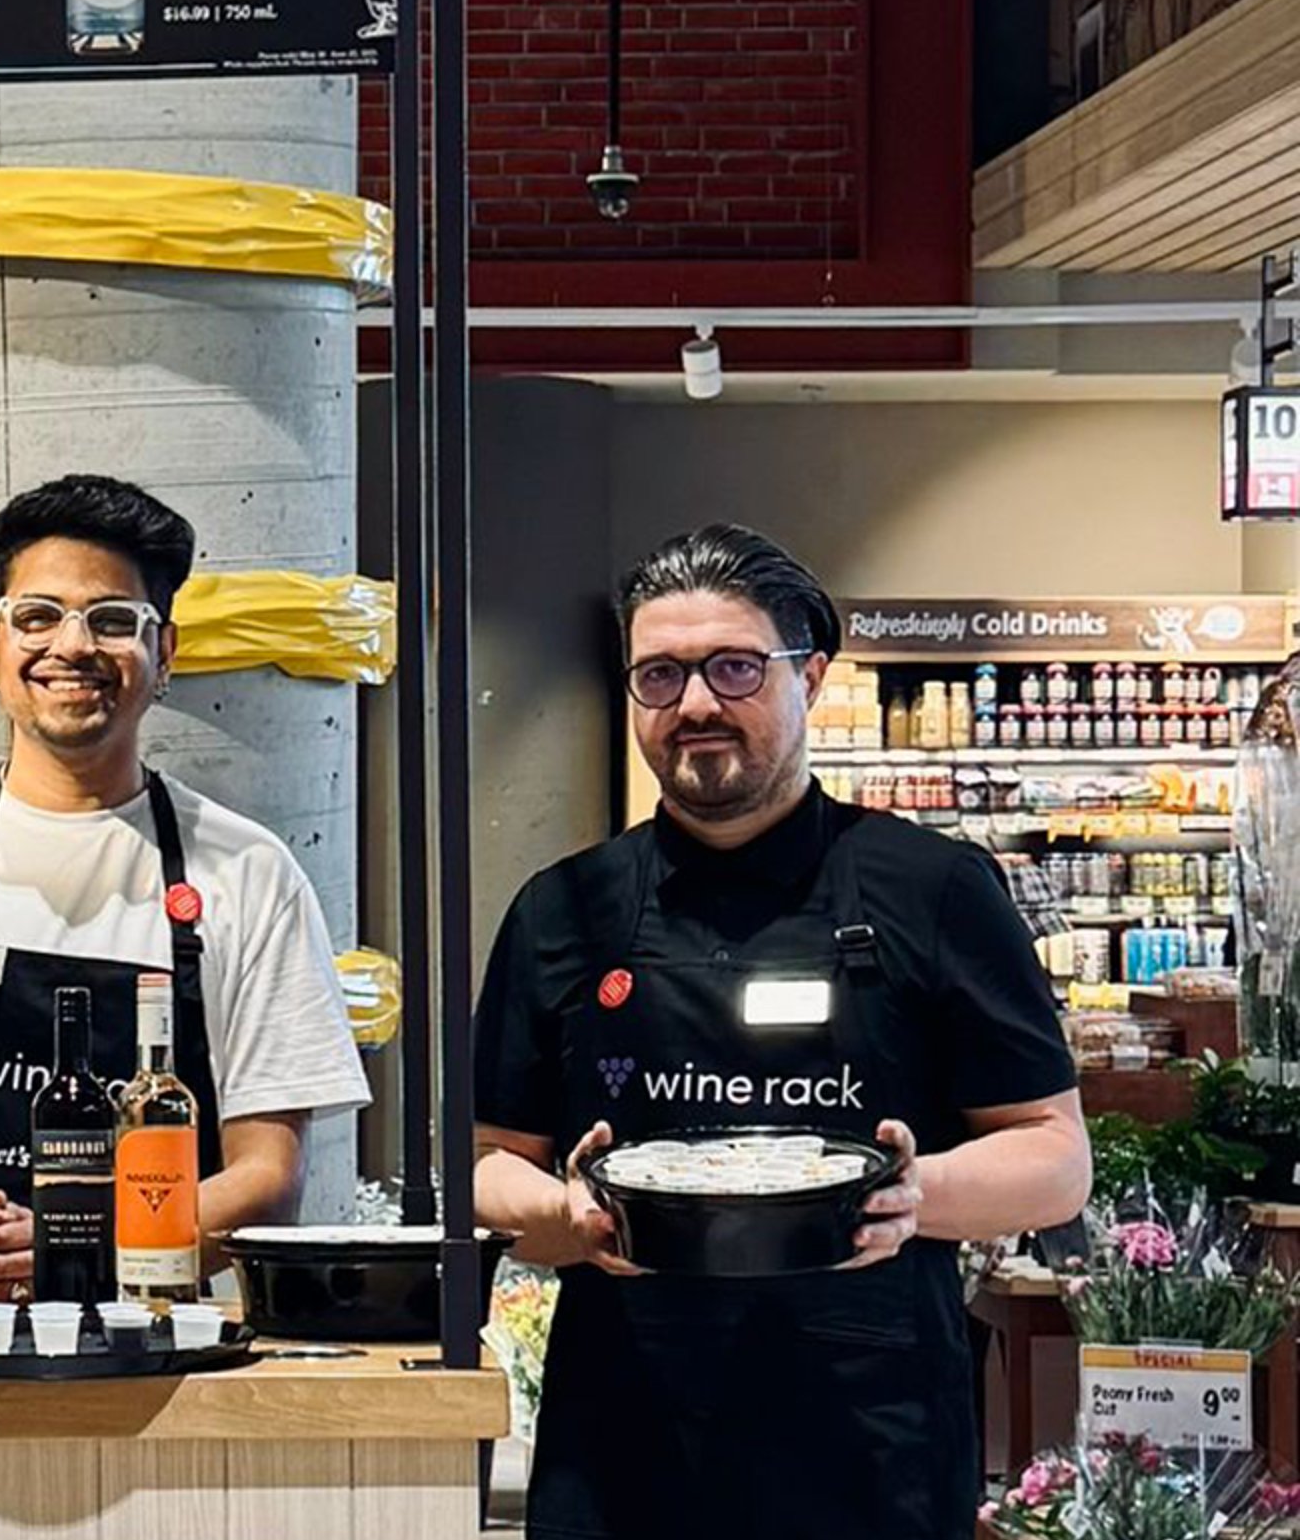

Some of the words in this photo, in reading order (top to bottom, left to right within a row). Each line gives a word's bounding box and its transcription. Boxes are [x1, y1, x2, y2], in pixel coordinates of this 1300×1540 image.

[224, 5, 250, 20] 750
[1253, 403, 1297, 440] 10
[848, 610, 968, 642] Refreshingly
[971, 611, 1024, 637] Cold
[1030, 611, 1109, 636] Drinks
[643, 1061, 754, 1105] wine
[764, 1063, 865, 1111] rack
[1136, 1385, 1175, 1403] Fresh
[1092, 1402, 1118, 1417] Cut
